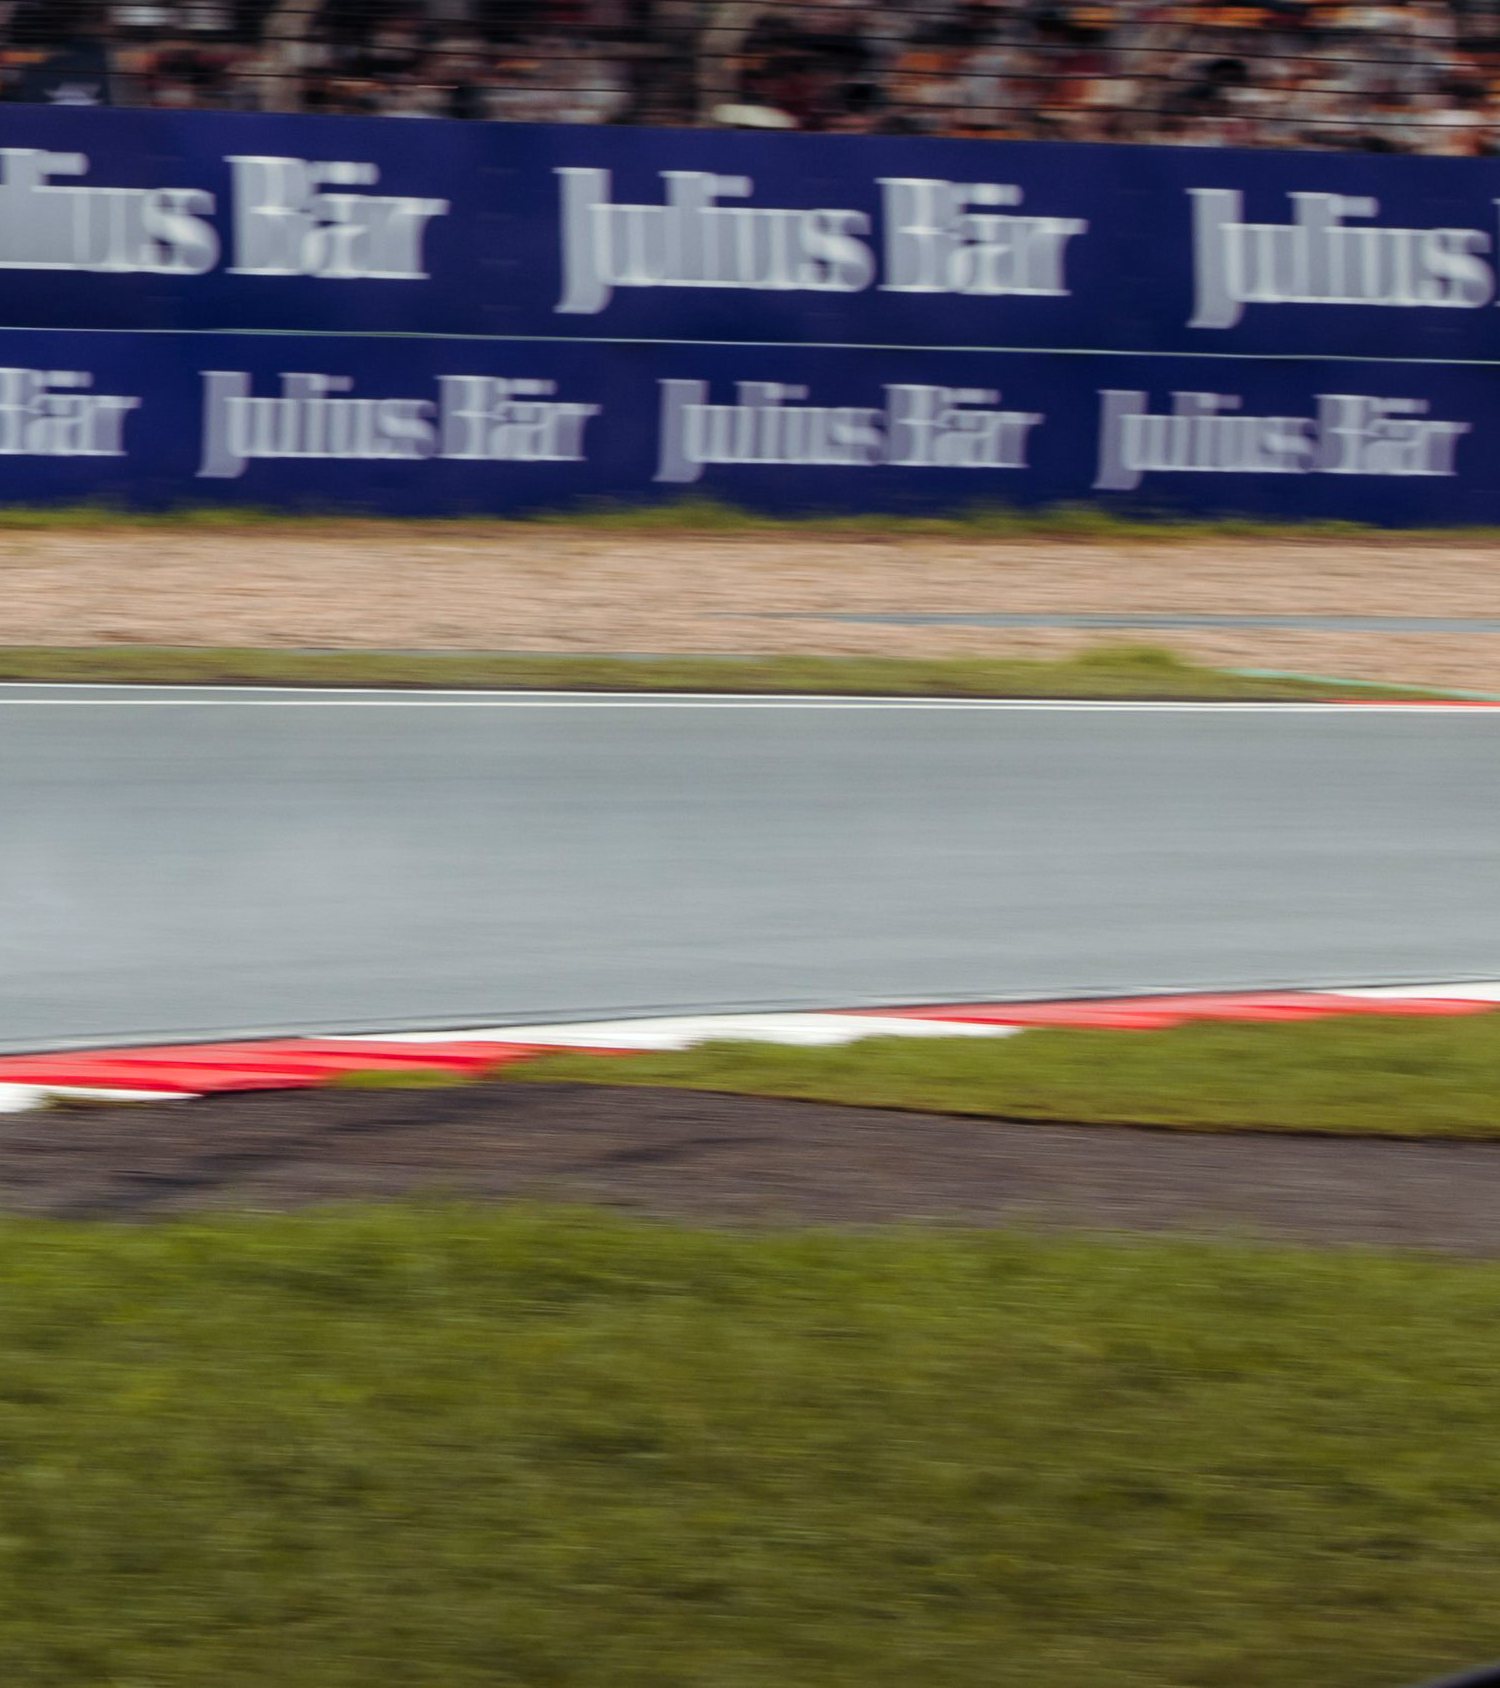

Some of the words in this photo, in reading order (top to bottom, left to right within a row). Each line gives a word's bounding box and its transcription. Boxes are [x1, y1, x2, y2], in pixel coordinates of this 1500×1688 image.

[223, 154, 450, 281] Bär
[552, 165, 876, 315] Julius
[875, 176, 1088, 298] Bär
[1185, 186, 1497, 330] Julius
[197, 370, 437, 479] Julius
[435, 374, 603, 463] Bär
[654, 378, 886, 483] Julius
[884, 383, 1045, 470] Bär
[1094, 389, 1316, 491] Julius
[1315, 393, 1471, 477] Bär
